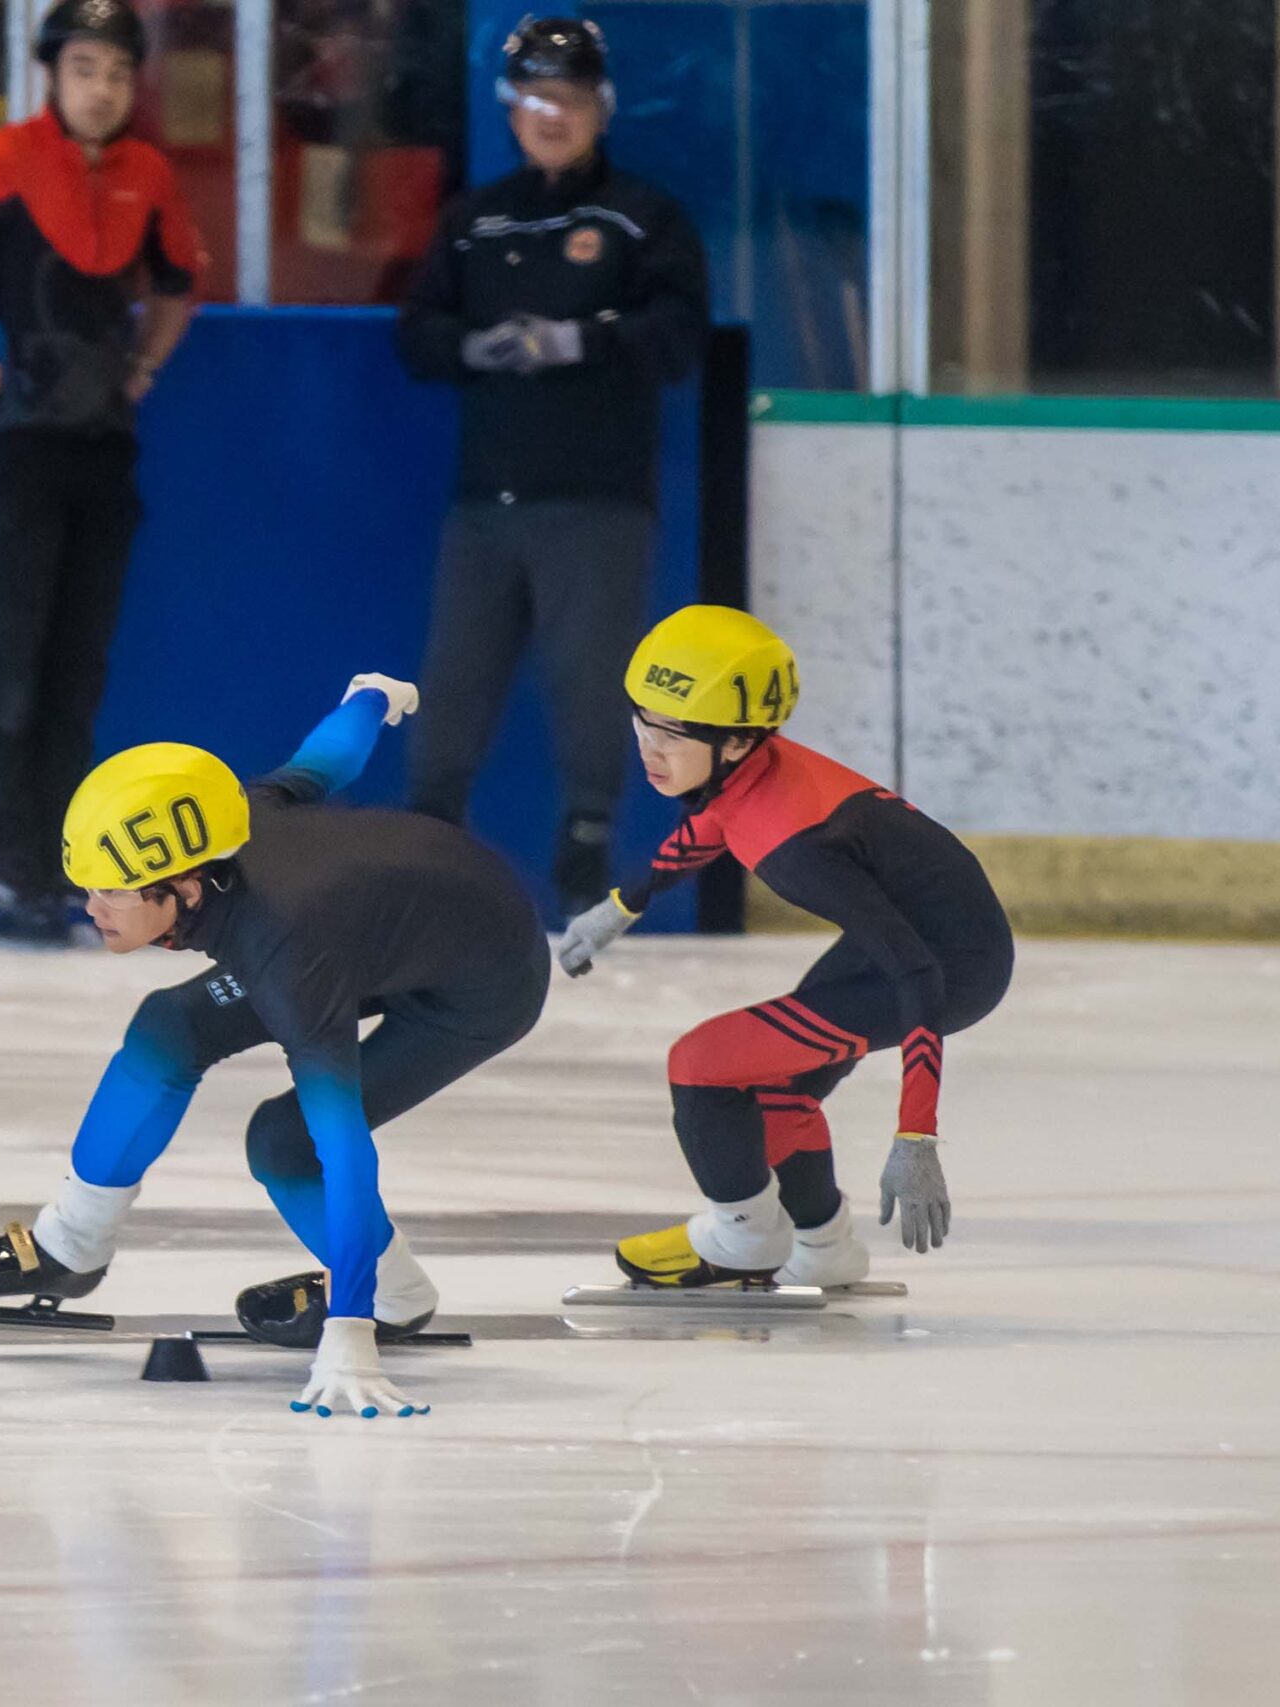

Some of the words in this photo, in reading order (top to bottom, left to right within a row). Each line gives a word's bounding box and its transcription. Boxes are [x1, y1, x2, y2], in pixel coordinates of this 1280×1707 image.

[98, 793, 211, 885] 150
[210, 981, 229, 1003] GEE
[223, 975, 242, 997] APO
